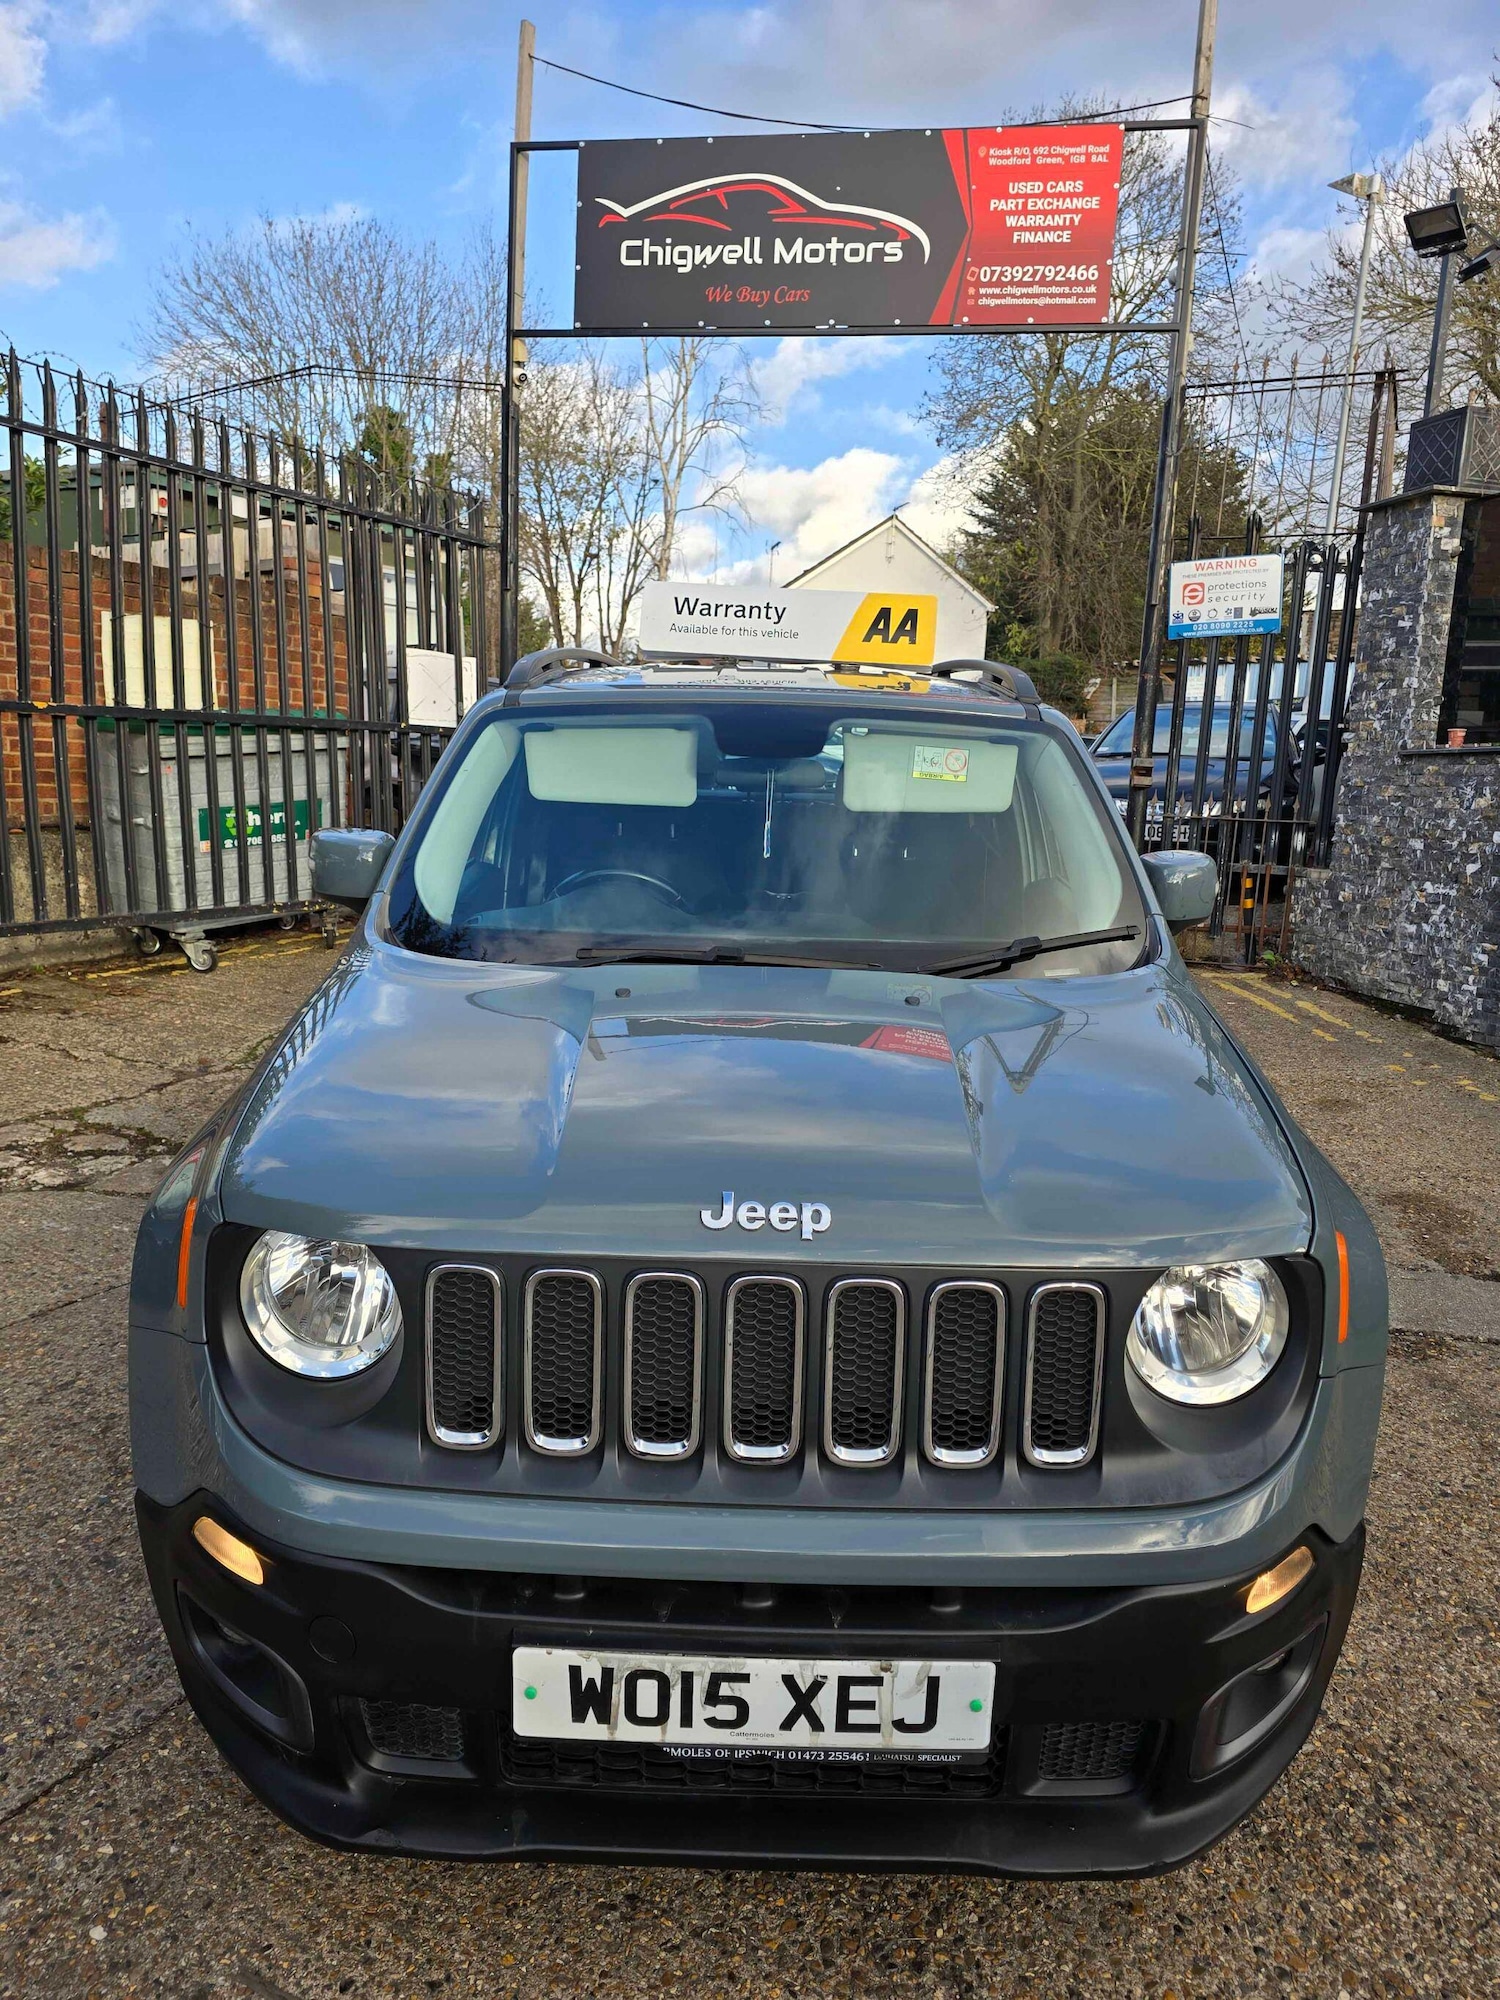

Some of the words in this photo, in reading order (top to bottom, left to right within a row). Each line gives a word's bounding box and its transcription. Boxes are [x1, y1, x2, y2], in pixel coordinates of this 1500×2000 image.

[989, 147, 1012, 156] Kiosk
[1033, 146, 1049, 155] 692
[1050, 145, 1086, 156] Chigwell
[1088, 144, 1110, 153] Road
[989, 156, 1031, 166] Woodford
[1036, 156, 1065, 165] Green,
[1070, 155, 1085, 163] IG8
[1091, 154, 1108, 163] 8AL
[1008, 182, 1043, 194] USED
[1046, 180, 1084, 193] CARS
[989, 199, 1025, 211] PART
[1027, 197, 1100, 211] EXCHANGE
[1005, 213, 1082, 227] WARRANTY
[1012, 230, 1072, 244] FINANCE
[619, 236, 763, 274] Chigwell
[773, 236, 904, 265] Motors
[979, 265, 1099, 282] 07392792466
[705, 284, 732, 303] We
[736, 285, 770, 308] Buy
[773, 285, 811, 303] Cars
[979, 284, 1097, 296] www.chigwellmotors.co.uk
[977, 296, 1096, 306] chigwellmotors@hotmail.com
[1195, 558, 1257, 572] WARNING
[1207, 580, 1267, 593] protections
[1207, 592, 1266, 603] security
[673, 596, 787, 624] Warranty
[669, 622, 718, 635] Available
[721, 624, 736, 636] for
[738, 626, 758, 638] this
[760, 627, 799, 640] vehicle
[861, 607, 919, 645] AA
[1192, 623, 1208, 631] 020
[1210, 622, 1231, 630] 8090
[1232, 621, 1254, 629] 2225
[700, 1190, 832, 1241] Jeep
[568, 1664, 751, 1731] WO15
[779, 1673, 940, 1734] XEJ
[788, 1751, 825, 1760] 01473
[917, 1754, 962, 1762] SPECIALIST
